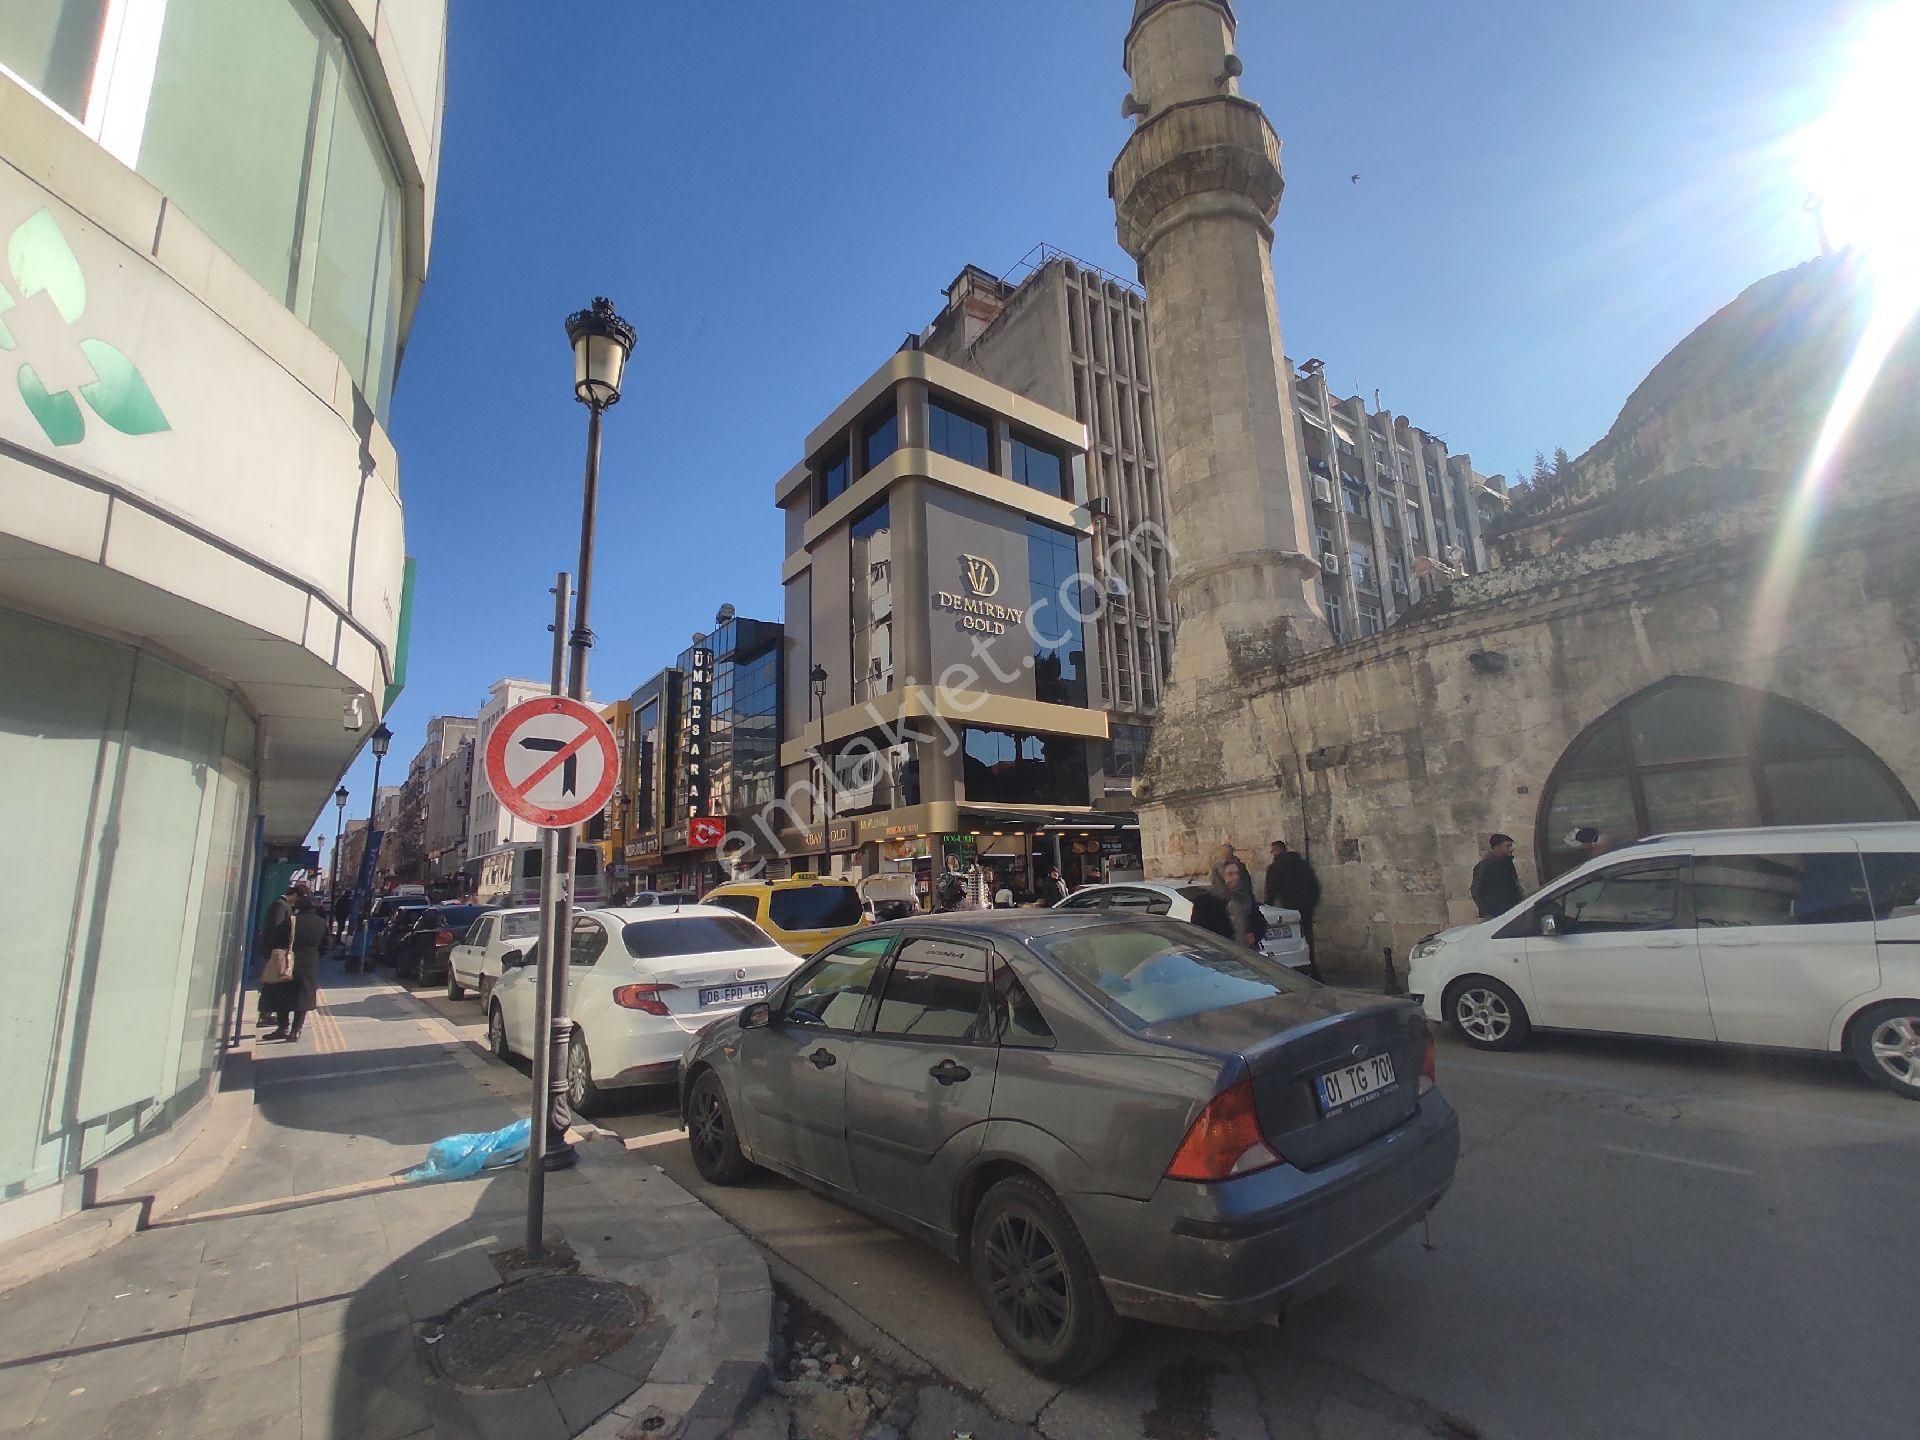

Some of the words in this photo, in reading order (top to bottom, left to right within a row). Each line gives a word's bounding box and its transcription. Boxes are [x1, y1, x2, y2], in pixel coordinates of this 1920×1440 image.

[963, 615, 1006, 636] GOLD
[830, 828, 847, 842] OLD
[707, 990, 720, 1003] 06
[748, 985, 766, 998] 153
[1325, 1075, 1343, 1103] 01
[1345, 1065, 1369, 1095] TG
